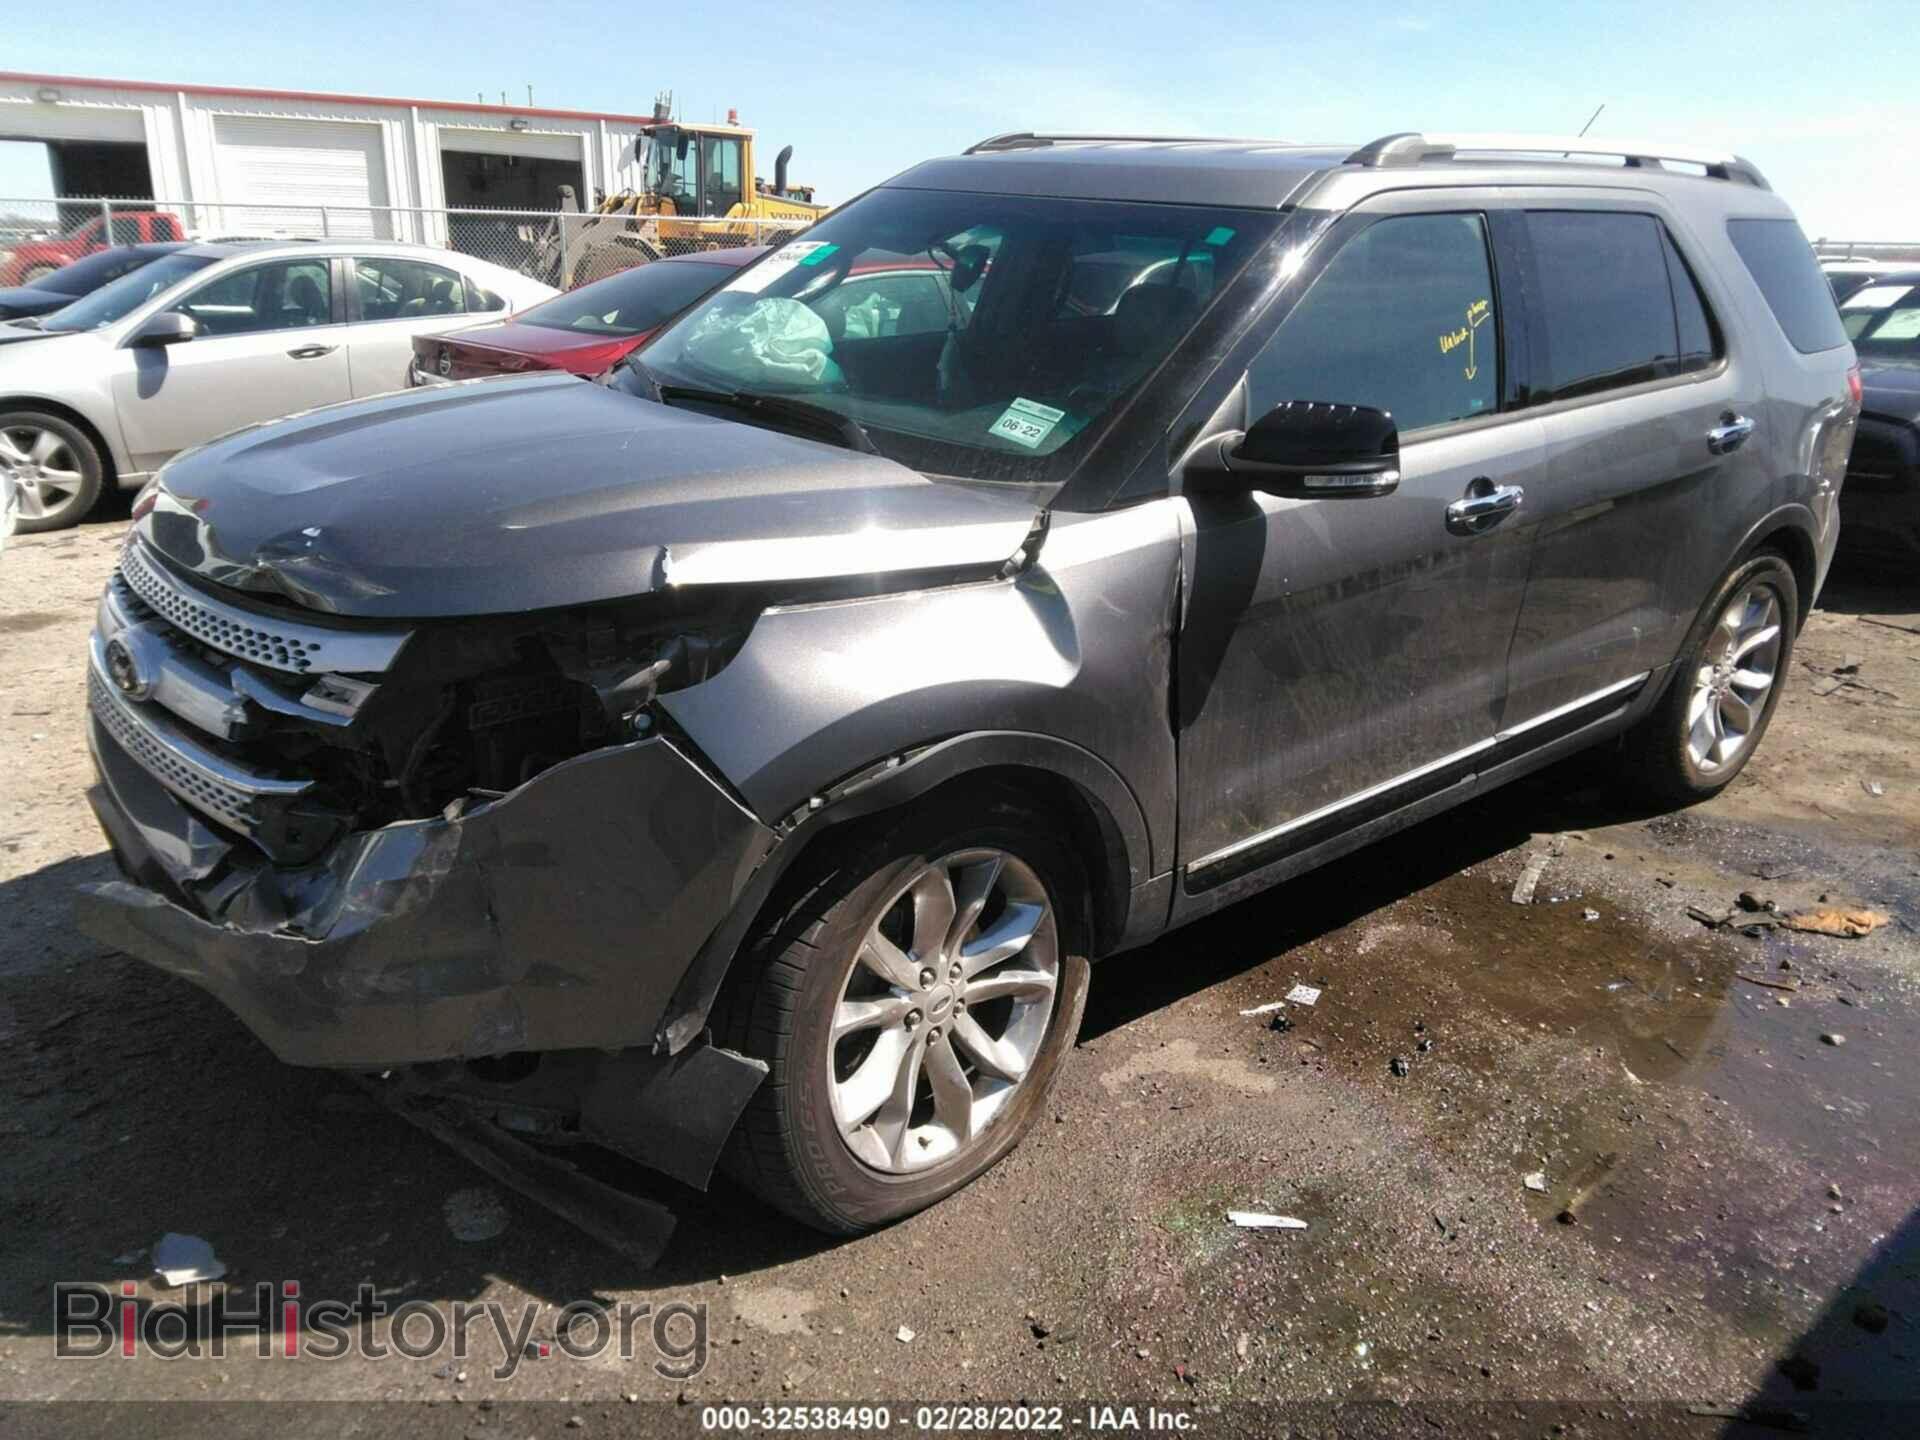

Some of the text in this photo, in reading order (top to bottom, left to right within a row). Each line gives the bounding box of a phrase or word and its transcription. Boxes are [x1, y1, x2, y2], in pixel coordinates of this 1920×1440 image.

[770, 211, 813, 221] VOLVO
[1002, 418, 1020, 431] 06
[1021, 425, 1041, 438] 22
